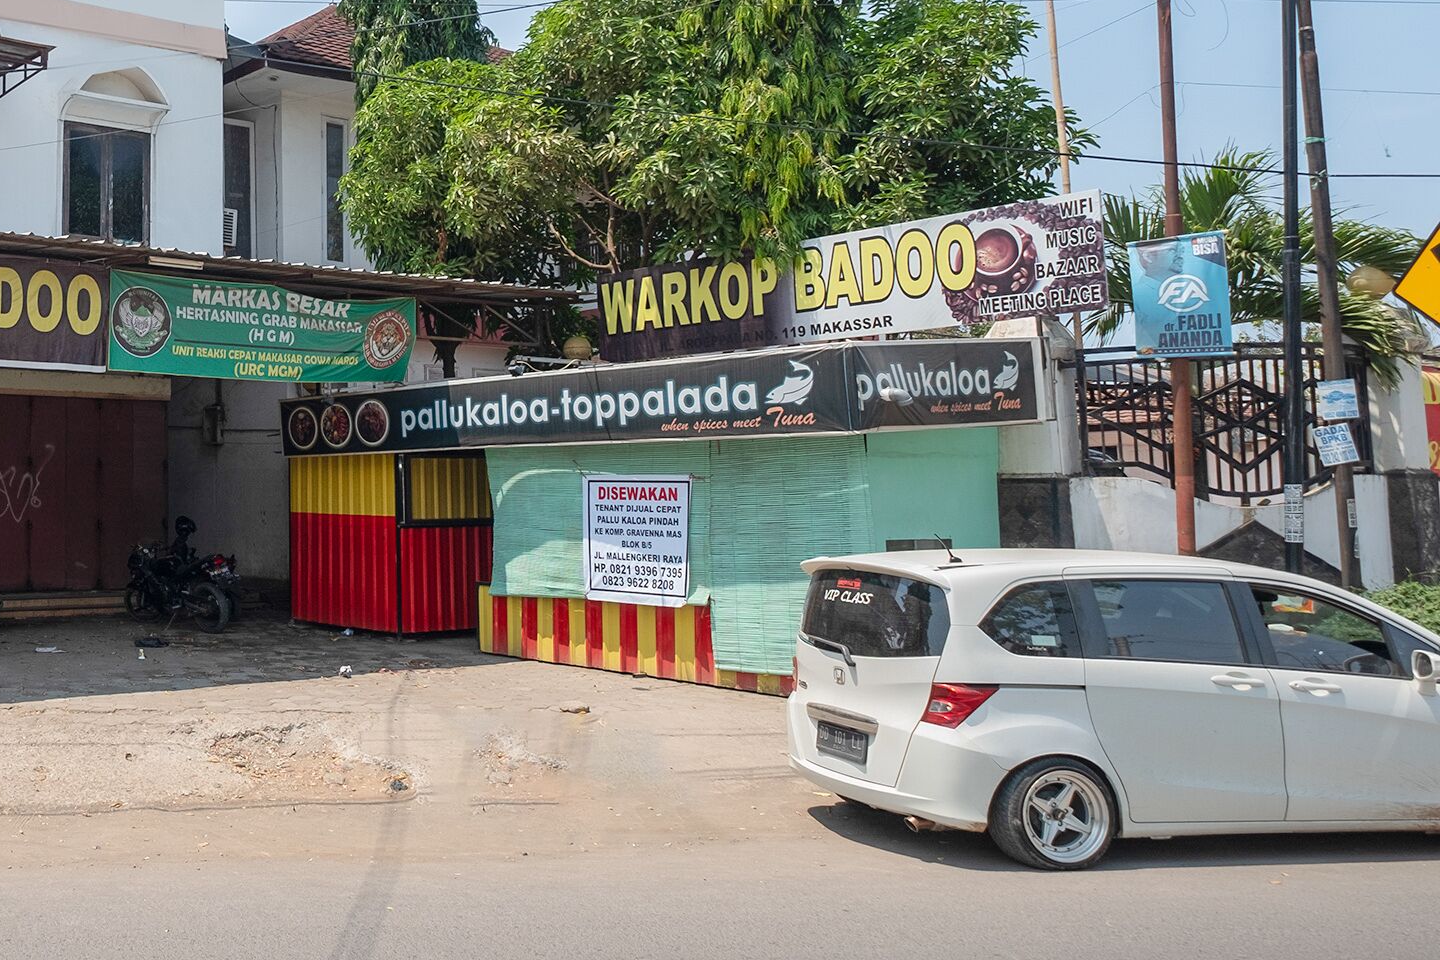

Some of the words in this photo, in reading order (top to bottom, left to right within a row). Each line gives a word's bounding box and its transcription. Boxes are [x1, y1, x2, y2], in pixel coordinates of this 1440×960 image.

[1060, 197, 1093, 219] WIFI
[1045, 225, 1097, 249] MUSIC
[1192, 242, 1219, 256] BISA
[1035, 255, 1100, 280] BAZAAR
[600, 256, 779, 336] WARKOP
[794, 222, 977, 313] BADOO
[192, 283, 281, 311] MARKAS
[286, 292, 351, 319] BESAR
[979, 291, 1047, 315] MEETING
[1049, 284, 1101, 308] PLACE
[175, 305, 259, 325] HERTASNING
[262, 313, 297, 329] GRAB
[300, 317, 363, 334] MAKASSAR
[781, 325, 806, 339] 119
[810, 315, 893, 336] MAKASSAR
[248, 328, 264, 344] (H
[267, 331, 276, 342] G
[279, 330, 295, 346] M)
[1158, 330, 1223, 348] ANANDA
[172, 345, 194, 357] UNIT
[196, 347, 226, 359] REAKSI
[228, 349, 257, 361] CEPAT
[258, 351, 302, 364] MAKASSAR
[304, 355, 331, 365] GOWA
[331, 355, 359, 366] MAROS
[233, 362, 266, 378] (URC
[267, 365, 303, 381] MGM)
[856, 362, 991, 411] pallukaloa
[930, 400, 949, 413] when
[950, 401, 972, 415] spices
[974, 400, 992, 411] meet
[994, 392, 1022, 411] Tuna
[661, 419, 689, 432] when
[694, 419, 728, 434] spices
[732, 416, 762, 428] meet
[765, 406, 817, 427] Tuna
[1315, 426, 1348, 438] GADAI
[1321, 433, 1348, 445] BPKB
[598, 486, 678, 501] DISEWAKAN
[595, 504, 624, 512] TENANT
[626, 505, 654, 513] DIJUAL
[597, 516, 620, 524] PALLU
[621, 516, 647, 525] KALOA
[649, 517, 679, 526] PINDAH
[605, 528, 625, 536] KOMP.
[626, 529, 664, 537] GRAVENNA
[606, 552, 660, 562] MALLENGKERI
[663, 555, 683, 564] RAYA
[594, 563, 608, 573] HP.
[610, 564, 631, 575] 0821
[635, 566, 657, 577] 9396
[661, 567, 683, 578] 7395
[602, 575, 625, 586] 0823
[628, 577, 649, 588] 9622
[652, 579, 674, 590] 8208
[824, 589, 840, 601] VIP
[840, 591, 874, 605] CLASS
[834, 730, 846, 746] 101
